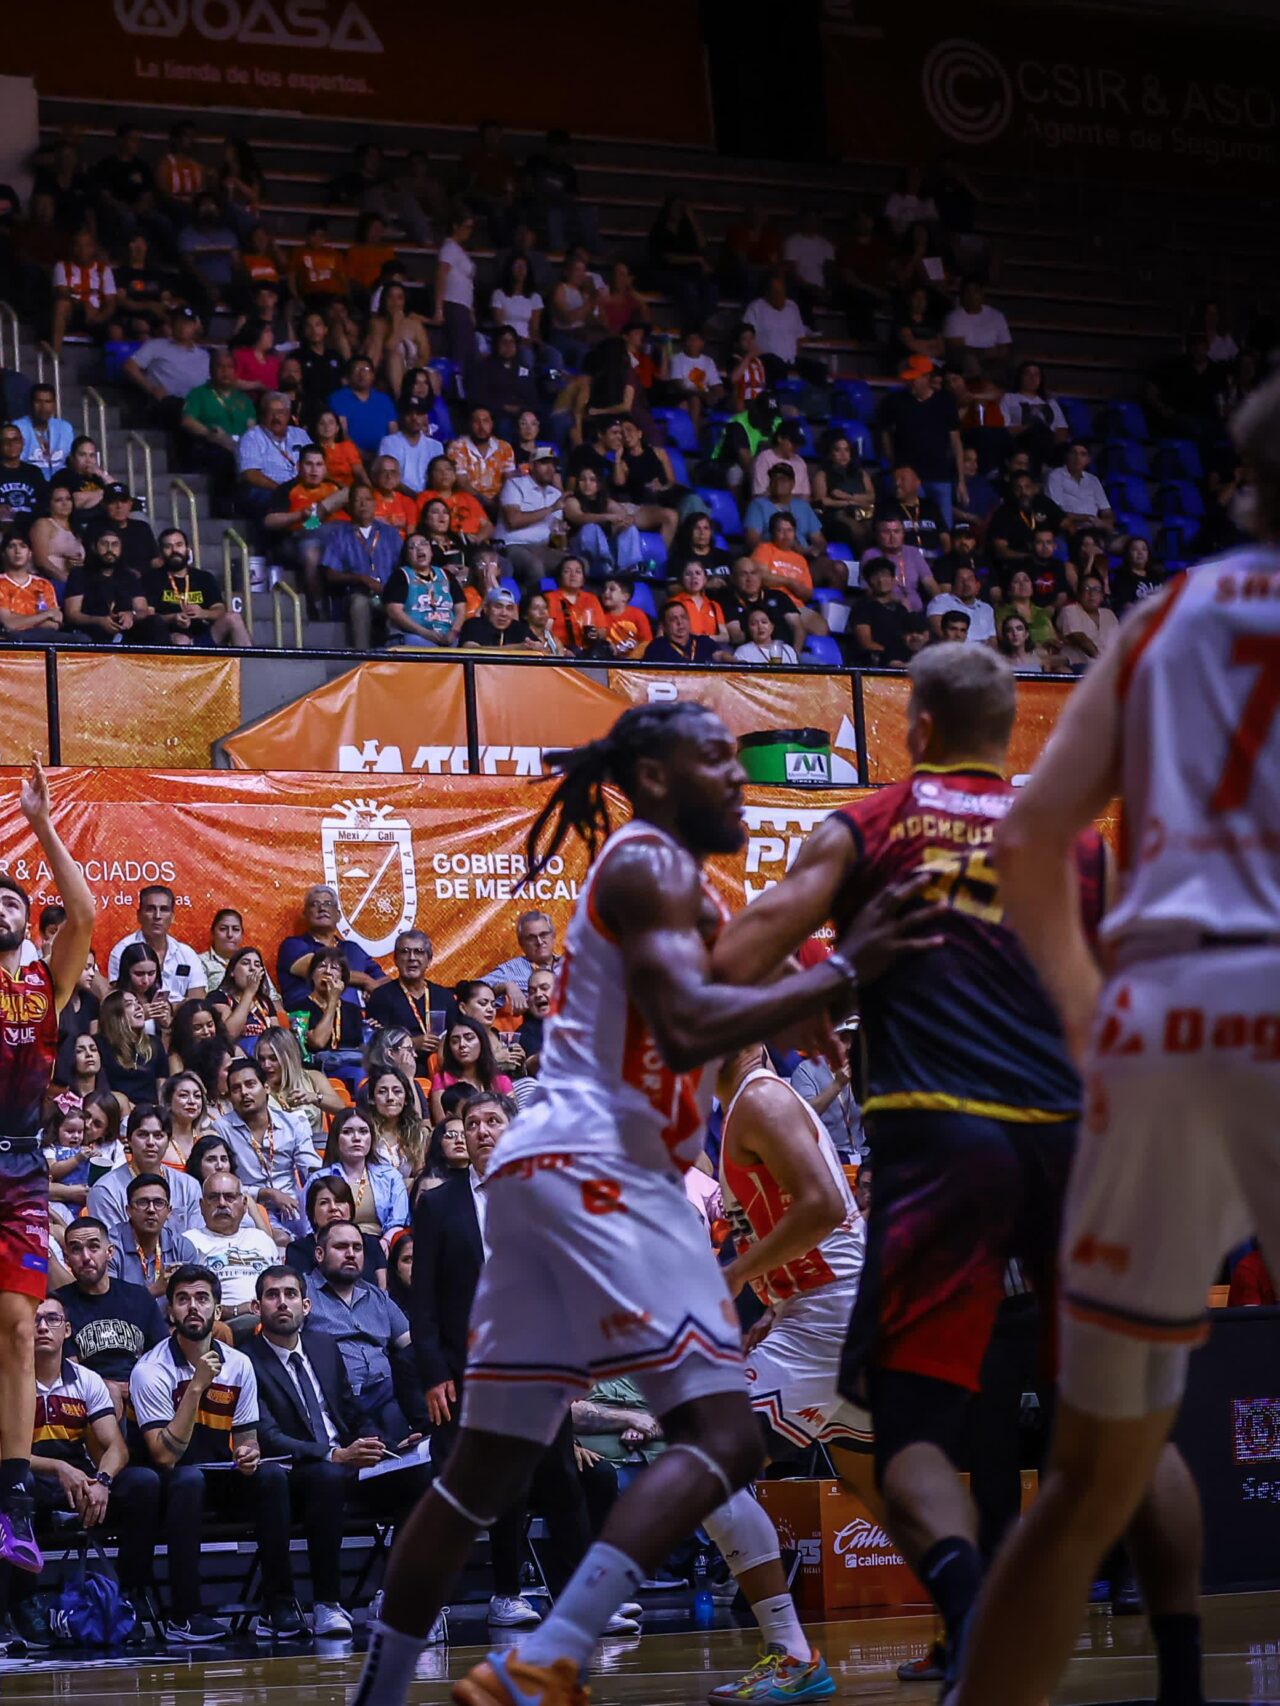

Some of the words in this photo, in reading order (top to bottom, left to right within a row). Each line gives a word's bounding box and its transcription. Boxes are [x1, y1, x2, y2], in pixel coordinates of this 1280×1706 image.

[1017, 59, 1132, 115] CSIR
[1140, 72, 1171, 119] &
[15, 860, 32, 882] &
[35, 860, 177, 883] AOCIADOS
[113, 891, 134, 907] de
[435, 878, 471, 900] DE
